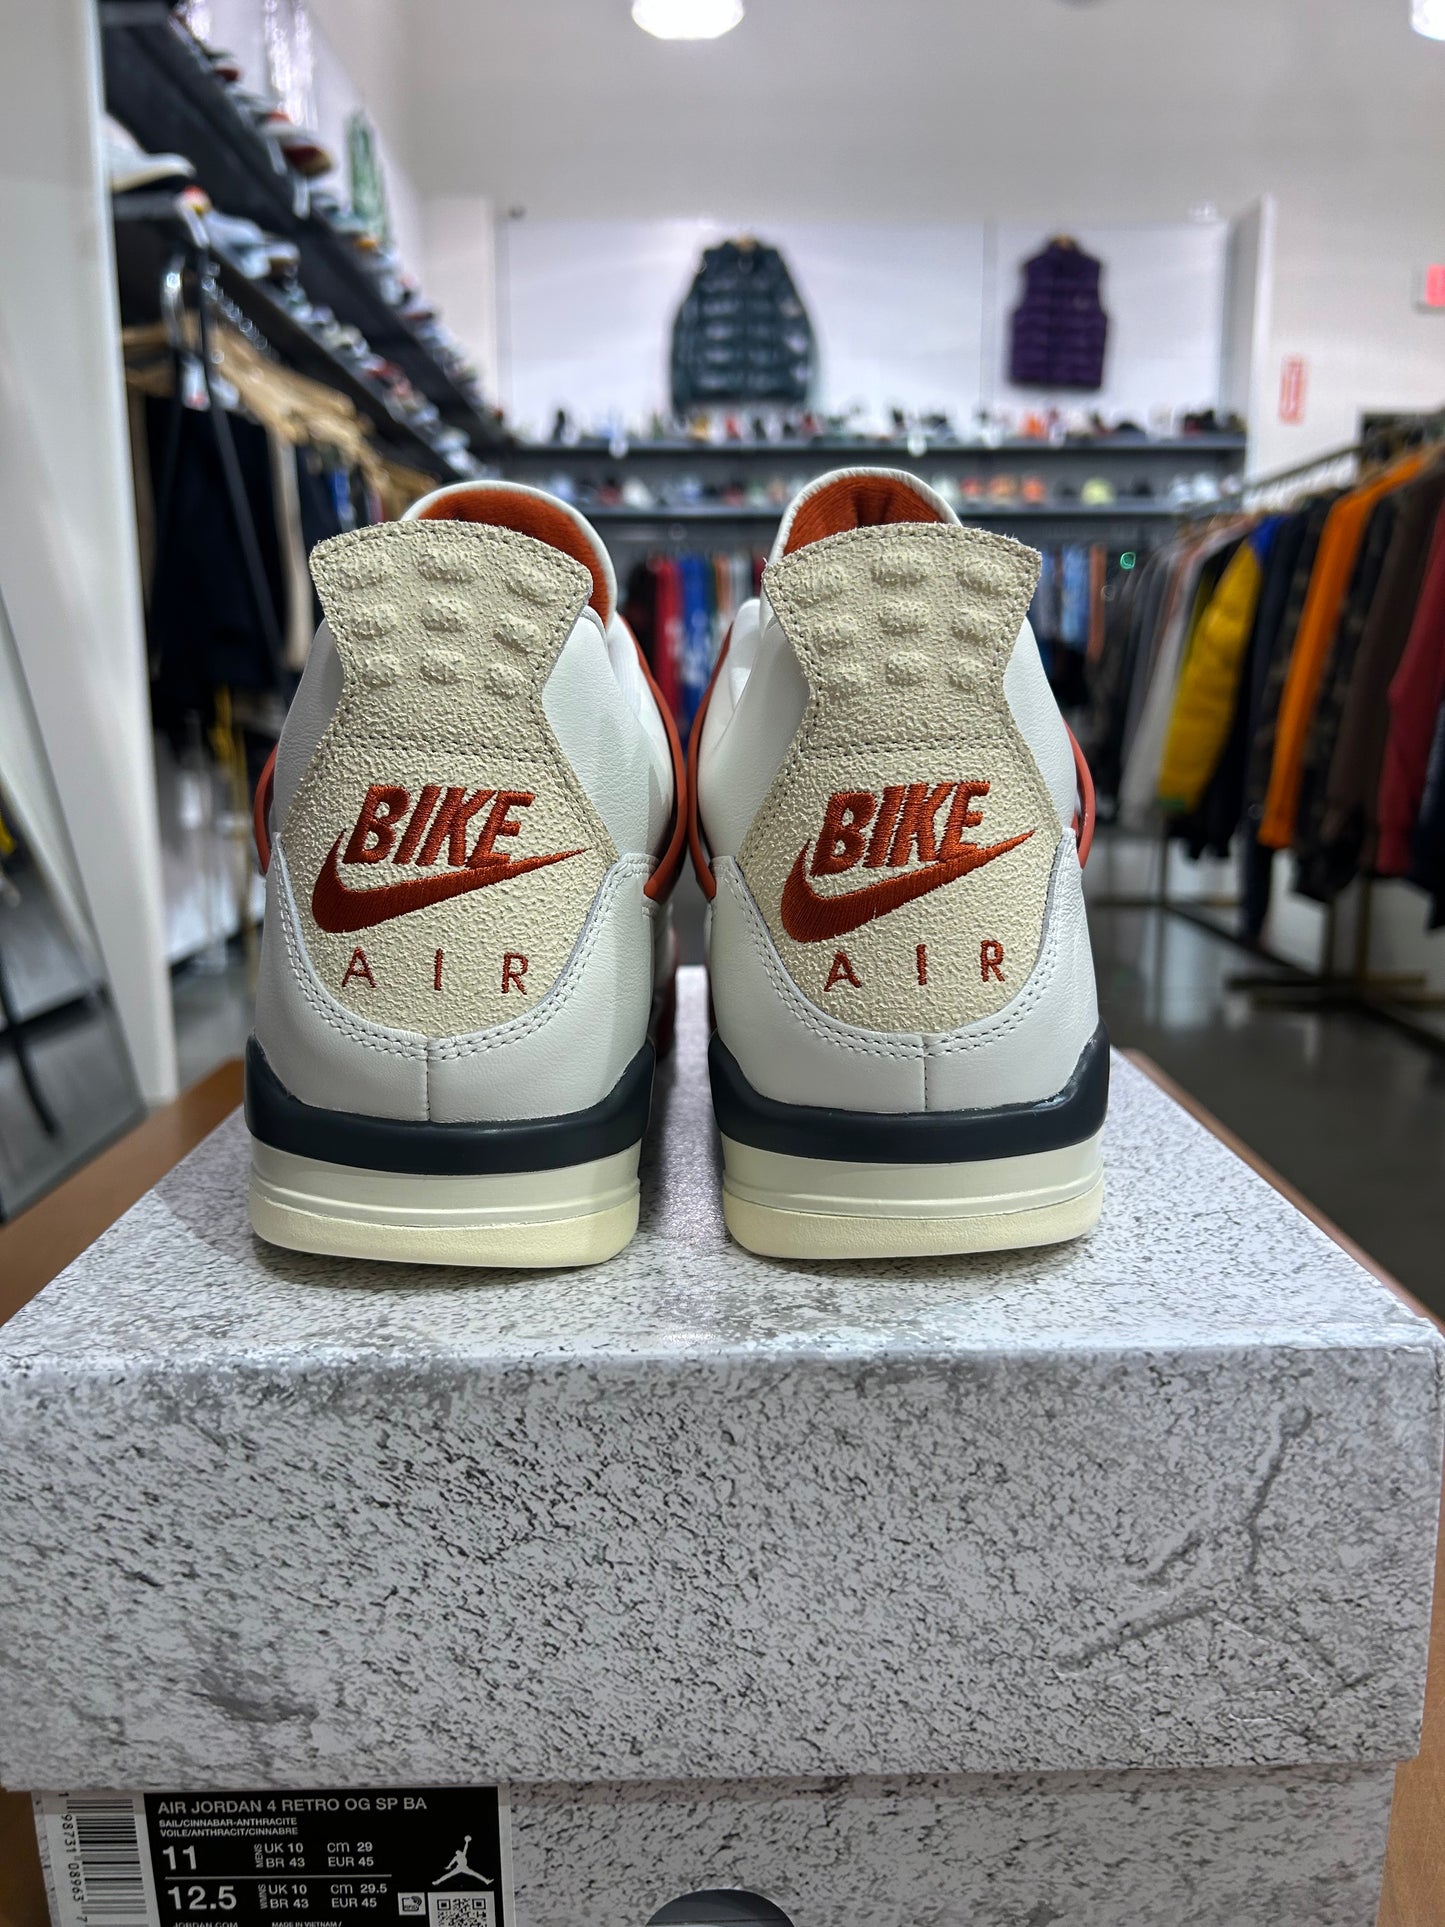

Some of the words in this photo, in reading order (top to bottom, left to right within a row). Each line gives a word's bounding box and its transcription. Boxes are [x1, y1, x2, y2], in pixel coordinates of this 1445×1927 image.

[342, 784, 535, 869] BIKE
[810, 780, 990, 876] BIKE
[342, 947, 528, 995] AIR
[824, 939, 1005, 992] AIR
[158, 1801, 187, 1814] AIR
[191, 1800, 262, 1814] JORDAN
[266, 1800, 277, 1812] 4
[282, 1798, 340, 1812] RETRO
[344, 1798, 371, 1811] OG
[376, 1797, 398, 1810] SP
[403, 1797, 428, 1810] BA
[159, 1817, 298, 1828] SAIL/CINNABAR-ANTHRACITE
[61, 1814, 77, 1853] 98731
[160, 1827, 299, 1837] VOILE/ANTHRACIT/CINNABRE
[264, 1843, 284, 1854] UK
[287, 1842, 304, 1853] 10
[327, 1842, 350, 1853] cm
[357, 1842, 373, 1852] 29
[162, 1845, 197, 1870] 11
[254, 1843, 264, 1868] MENS
[265, 1857, 285, 1869] BR
[289, 1856, 306, 1868] 43
[328, 1856, 355, 1868] EUR
[358, 1856, 374, 1867] 45
[67, 1862, 84, 1902] 08963
[268, 1884, 288, 1895] UK
[291, 1884, 308, 1895] 10
[330, 1884, 353, 1895] cm
[360, 1883, 388, 1894] 29.5
[167, 1885, 237, 1910] 12.5
[269, 1898, 289, 1909] BR
[293, 1898, 309, 1909] 43
[331, 1898, 358, 1908] EUR
[361, 1897, 377, 1908] 45
